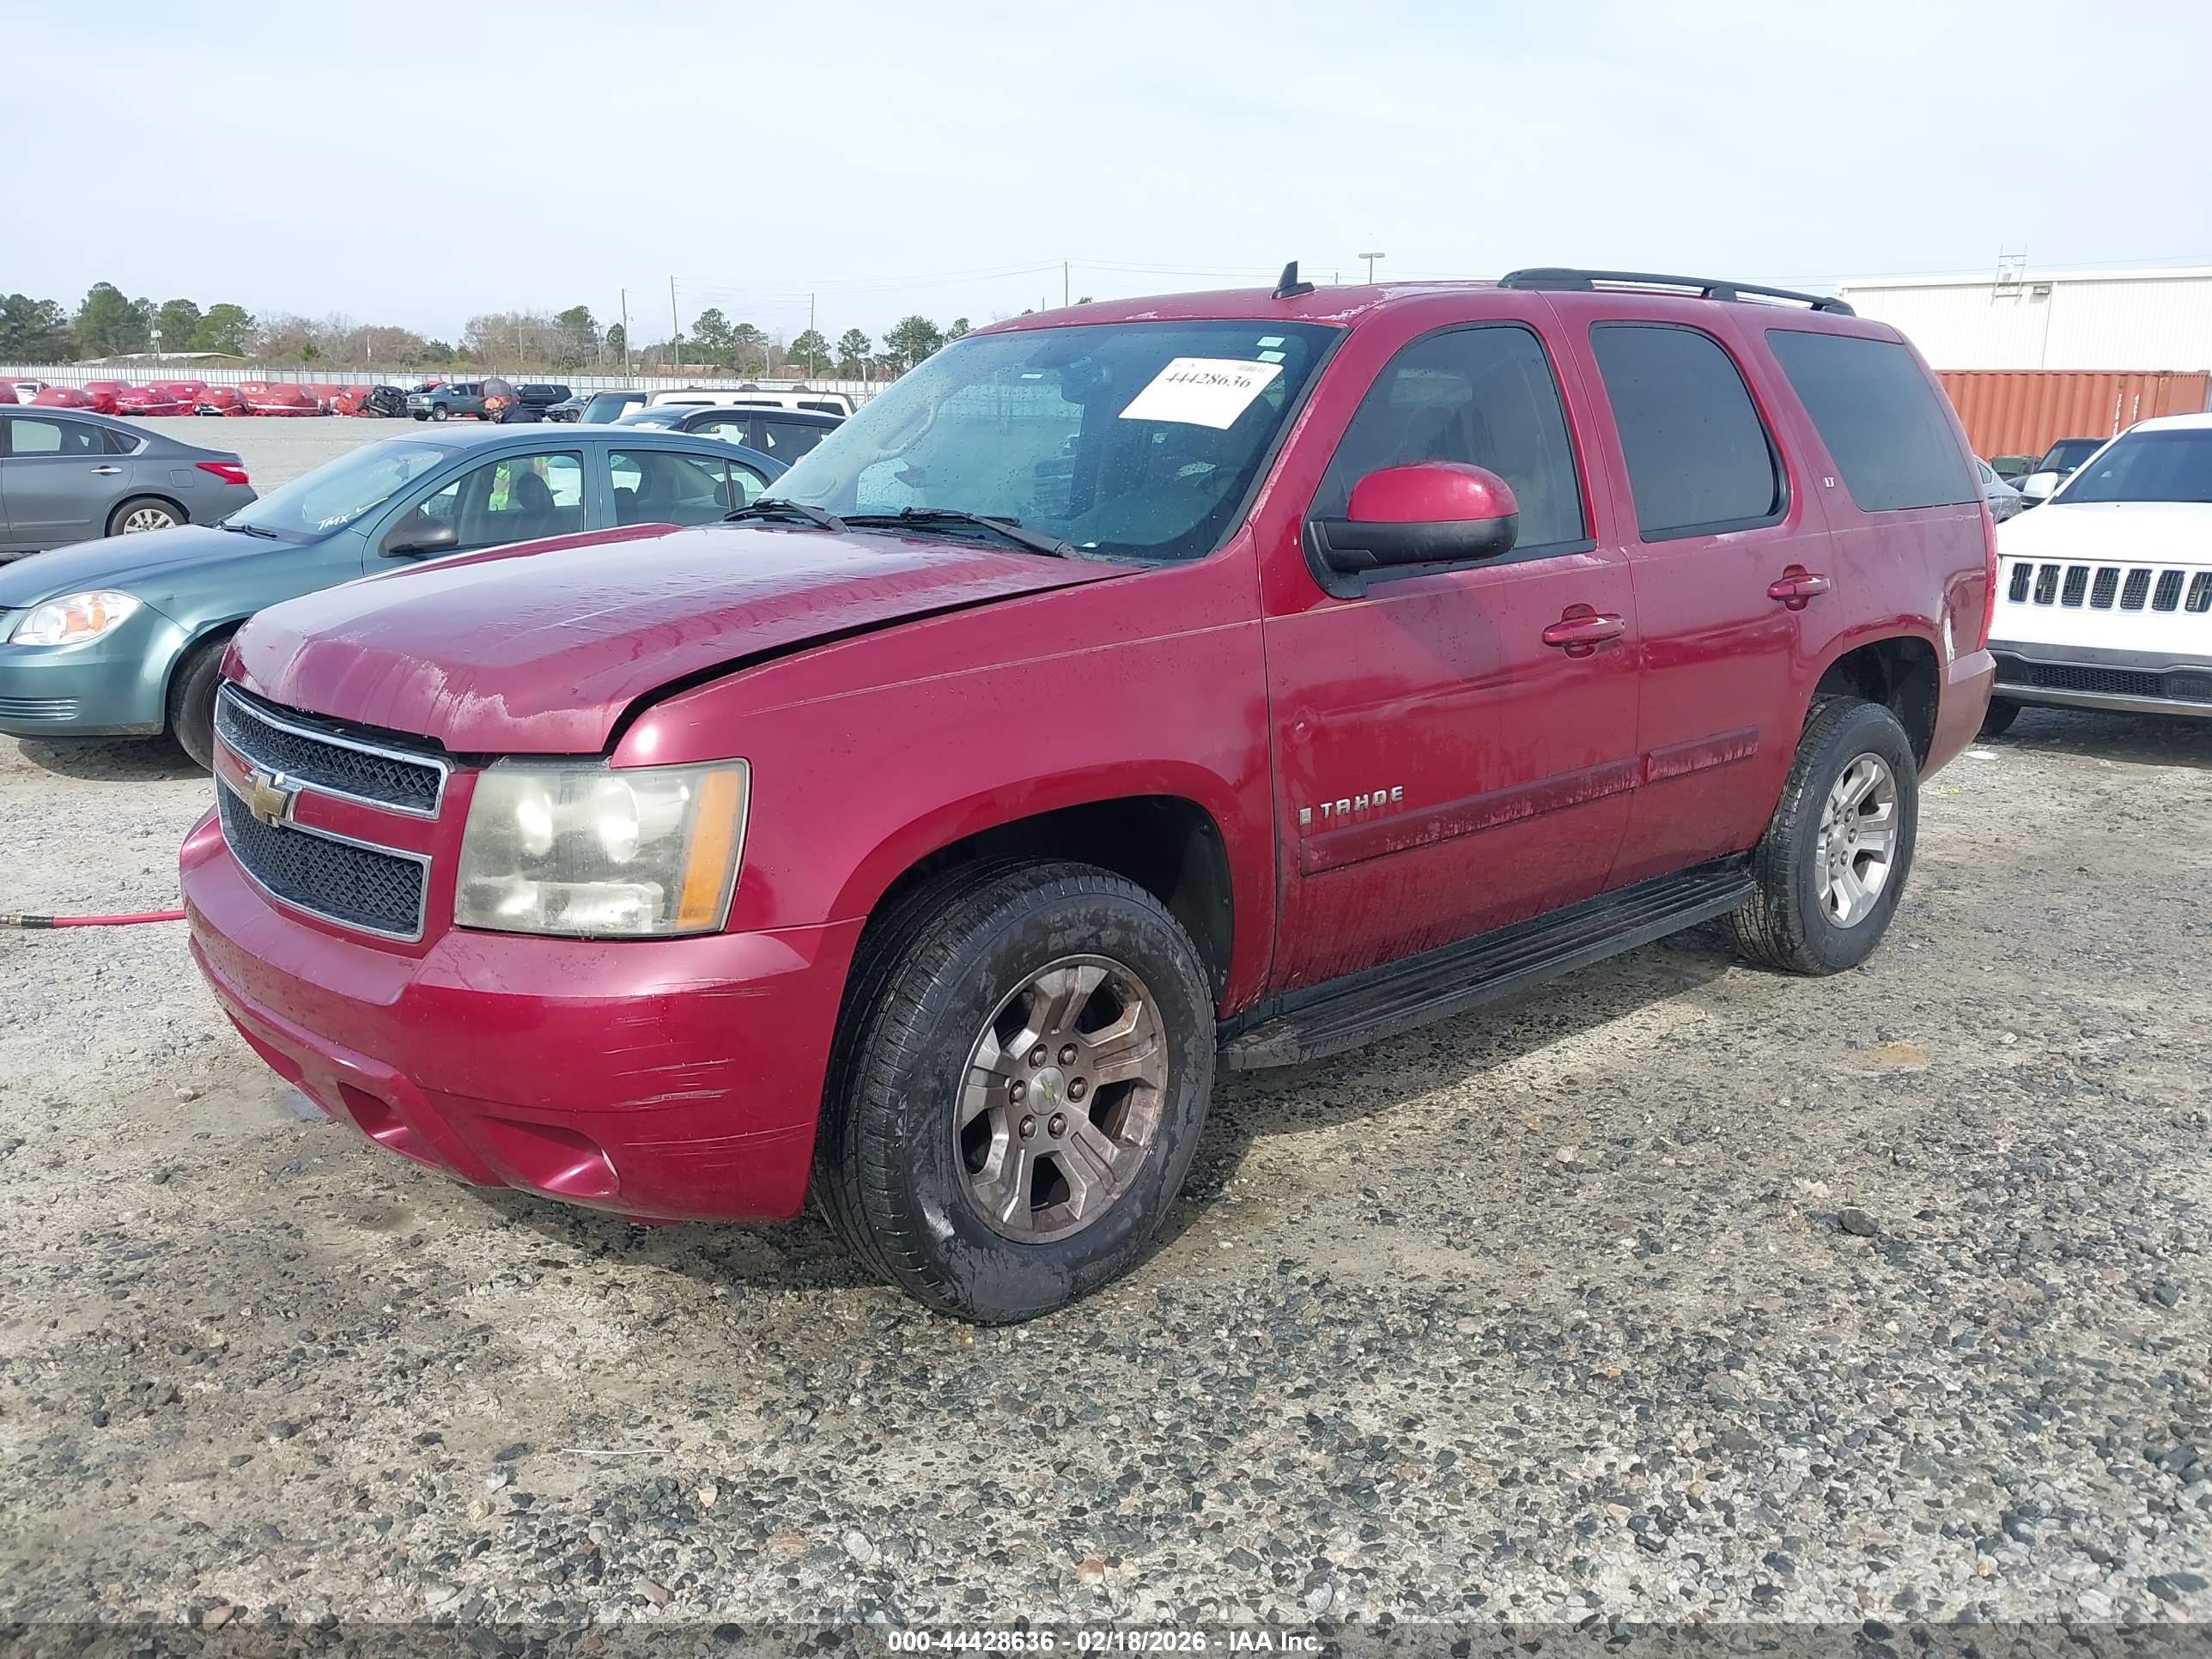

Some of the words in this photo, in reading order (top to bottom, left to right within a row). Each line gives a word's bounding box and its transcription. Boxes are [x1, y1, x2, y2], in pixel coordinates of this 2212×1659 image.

[1165, 371, 1252, 389] 44428636
[1823, 476, 1835, 488] LT
[317, 513, 351, 532] TMX
[1319, 785, 1404, 820] TAHOE
